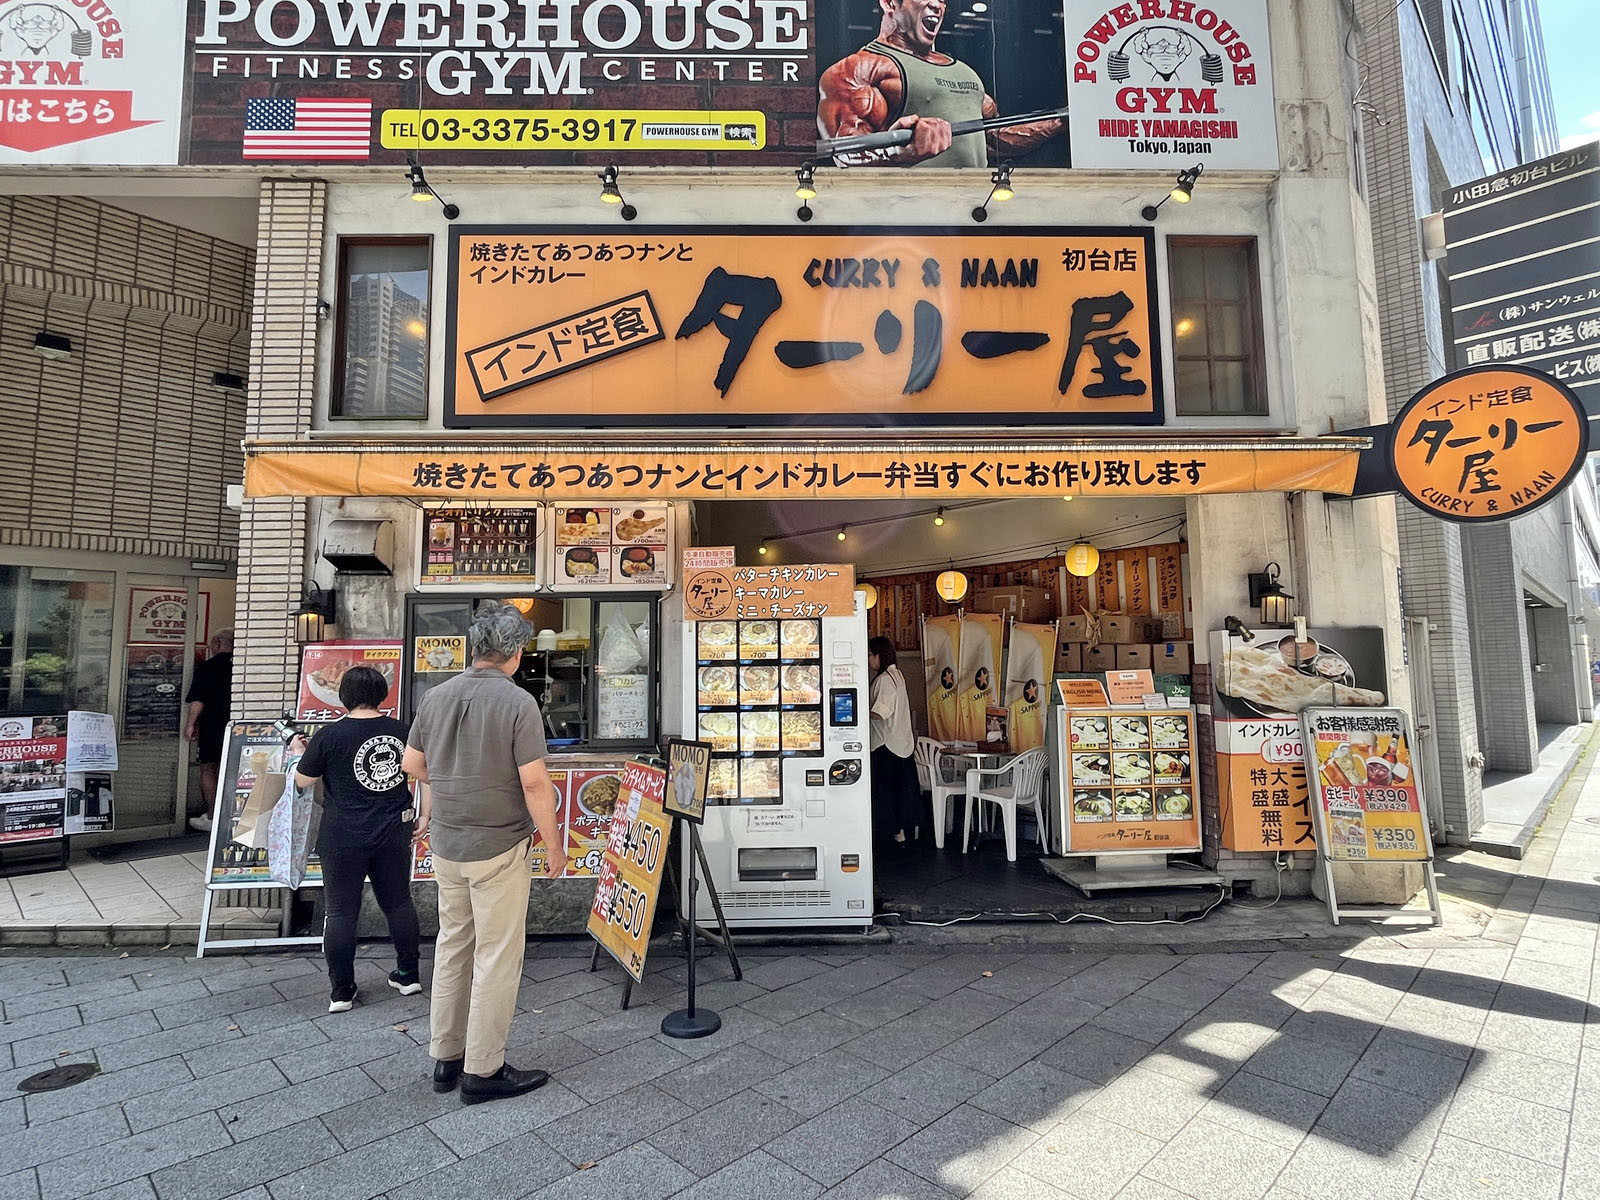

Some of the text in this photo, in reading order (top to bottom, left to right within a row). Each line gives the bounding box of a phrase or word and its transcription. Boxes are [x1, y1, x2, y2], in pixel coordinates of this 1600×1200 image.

[195, 0, 808, 50] POWERHOUSE
[1074, 0, 1257, 86] POWERHOUSE
[212, 56, 414, 80] FITNESS
[426, 50, 588, 96] GYM
[602, 59, 799, 82] CENTER
[0, 98, 115, 124] はこちら
[1115, 86, 1219, 115] GYM
[389, 118, 637, 142] TEL 03-3375-3917
[646, 127, 719, 137] POWERHOUSE GYM
[728, 126, 753, 138] 検索
[1098, 118, 1238, 139] HIDE YAMAGISHI
[1128, 139, 1212, 155] Tokyo, Japan
[1452, 151, 1589, 205] 小田急初台ビル
[469, 242, 693, 263] 焼きたてあつあつナンと
[1062, 247, 1138, 272] 初台店
[469, 264, 586, 285] インドカレー
[802, 257, 1039, 288] CURRY & NAAN
[483, 306, 650, 382] インド定食
[674, 266, 1147, 399] ターリー屋
[1426, 385, 1534, 417] インド定食
[1406, 417, 1564, 467] ターリー
[412, 459, 1208, 490] 焼きたてあつあつナンとインドカレー弁当すぐにお作り致します
[1457, 449, 1502, 495] 屋
[1421, 470, 1557, 513] CURRY & NAAN
[684, 559, 734, 568] 24時間販売中
[733, 567, 840, 584] バターチキンカレー
[1104, 561, 1114, 585] サモサ
[690, 583, 729, 600] ターリー
[734, 585, 805, 601] キーマカレー
[1130, 558, 1143, 611] ガーリックナン
[139, 594, 188, 619] POWERHO
[702, 596, 714, 611] 屋
[735, 602, 829, 619] ミニ・チーズナン
[365, 651, 398, 659] テイクアウト
[420, 638, 461, 648] MOMO
[1238, 722, 1301, 738] インドカレ
[1316, 716, 1400, 732] お客様感謝祭
[0, 743, 58, 754] RHOUSE
[1317, 732, 1349, 741] 期間限定
[673, 745, 705, 766] MOMO
[1250, 767, 1270, 807] 特盛
[1270, 767, 1290, 807] 大盛
[1326, 787, 1359, 800] 生ビール
[1364, 789, 1408, 802] ¥390
[1260, 809, 1284, 847] 無料
[1372, 828, 1416, 842] ¥350
[621, 819, 662, 874] ¥450
[607, 879, 648, 940] ¥550
